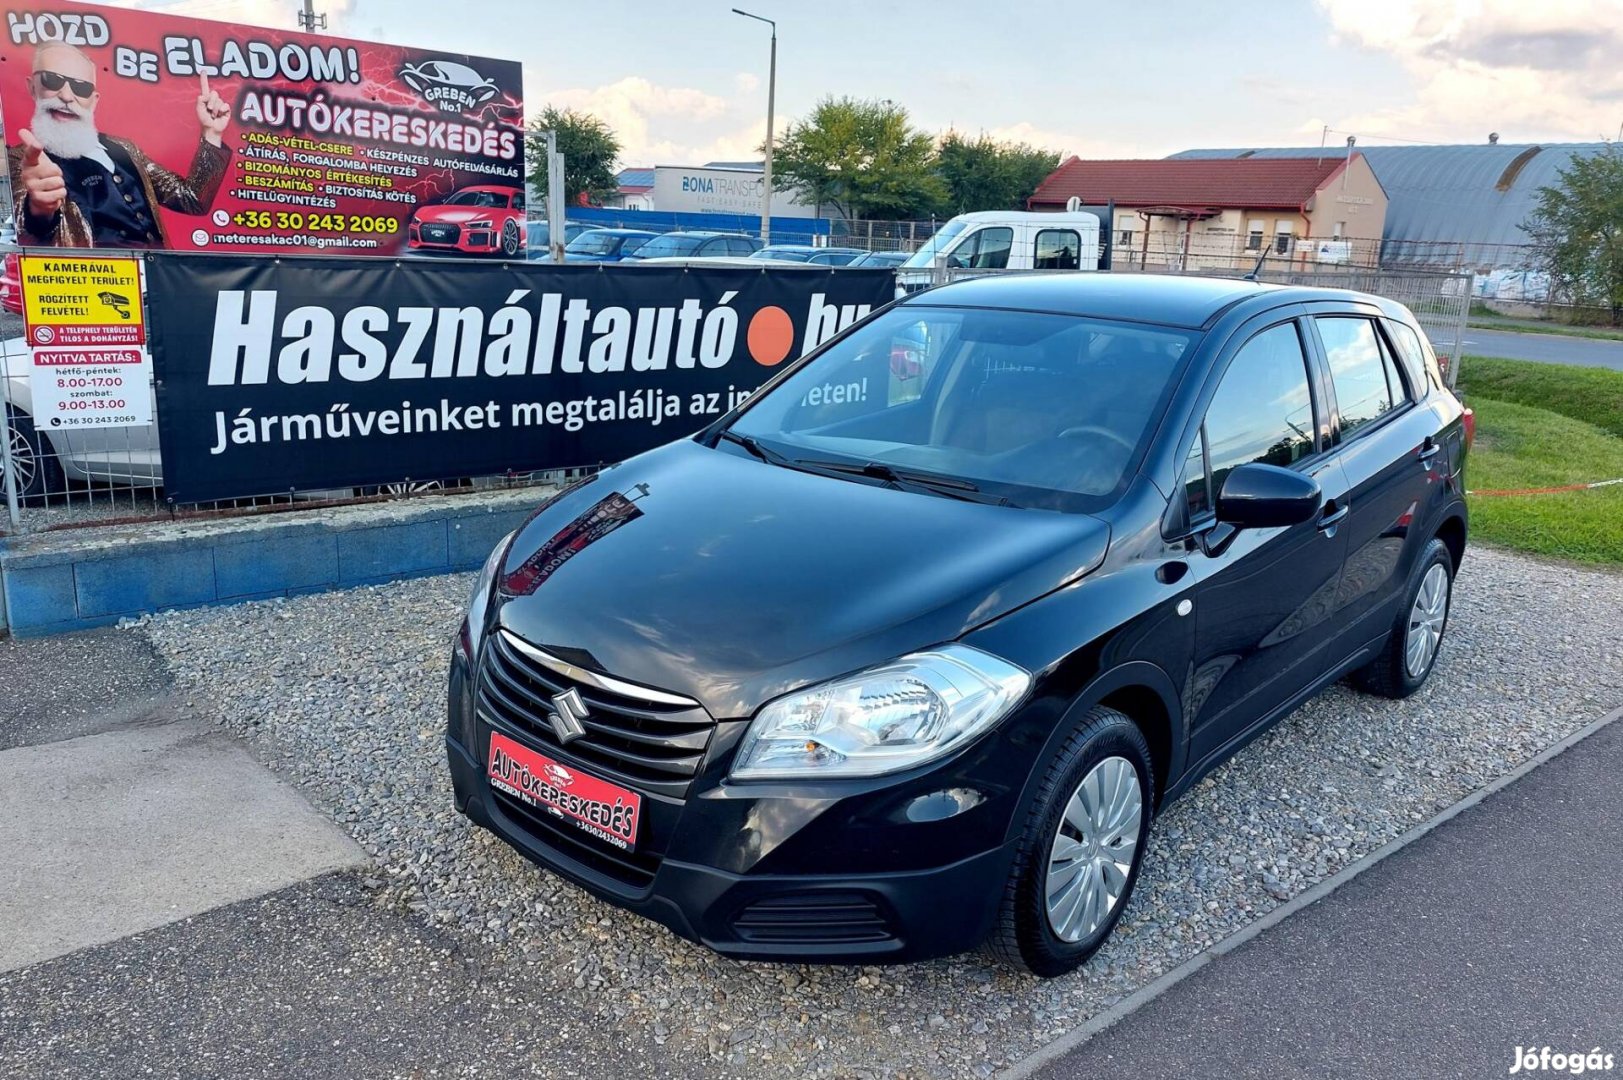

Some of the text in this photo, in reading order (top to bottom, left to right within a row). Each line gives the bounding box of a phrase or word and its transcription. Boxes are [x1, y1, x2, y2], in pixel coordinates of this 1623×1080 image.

[8, 12, 109, 46] HOZD
[116, 36, 360, 83] BE ELADOM!
[424, 86, 476, 109] GREBEN
[440, 100, 461, 113] No.1
[241, 92, 516, 160] AUTÓKERESKEDÉS
[248, 132, 354, 156] ADÁS-VÉTEL-CSERE
[245, 145, 418, 177] ÁTÍRÁS, FORGALOMBA HELYEZÉS
[366, 147, 519, 178] KÉSZPÉNZES AUTÓFELVÁSÁRLÁS
[244, 161, 393, 187] BIZOMÁNYOS ÉRTÉKESÍTÉS
[237, 188, 337, 209] HITELÜGYINTÉZÉS
[244, 175, 417, 204] BESZÁMÍTÁS BIZTOSÍTÁS KÖTÉS
[233, 211, 398, 234] +36 30 243 2069
[44, 261, 117, 274] KAMERÁVAL
[27, 275, 135, 286] MEGFIGYELT TERÜLET!
[38, 293, 89, 304] RÖGZÍTETT
[41, 305, 89, 316] FELVÉTEL!
[60, 333, 138, 343] TILOS A DOHÁNYZÁS!
[66, 327, 101, 335] TELEPHELY
[101, 325, 138, 334] TERÜLETÉN
[207, 288, 740, 387] Használtautó
[40, 350, 136, 364] NYITVA TARTÁS:
[56, 366, 122, 376] hétfő-péntek:
[57, 377, 123, 388] 8.00-17.00
[70, 389, 113, 398] szombat:
[58, 399, 126, 411] 9.00-13.00
[63, 415, 136, 425] +36 30 243 2069
[210, 399, 500, 455] Járműveinket
[512, 389, 680, 431] megtalálja
[689, 391, 720, 414] az
[491, 746, 635, 838] AUTÓKERESKEDÉS
